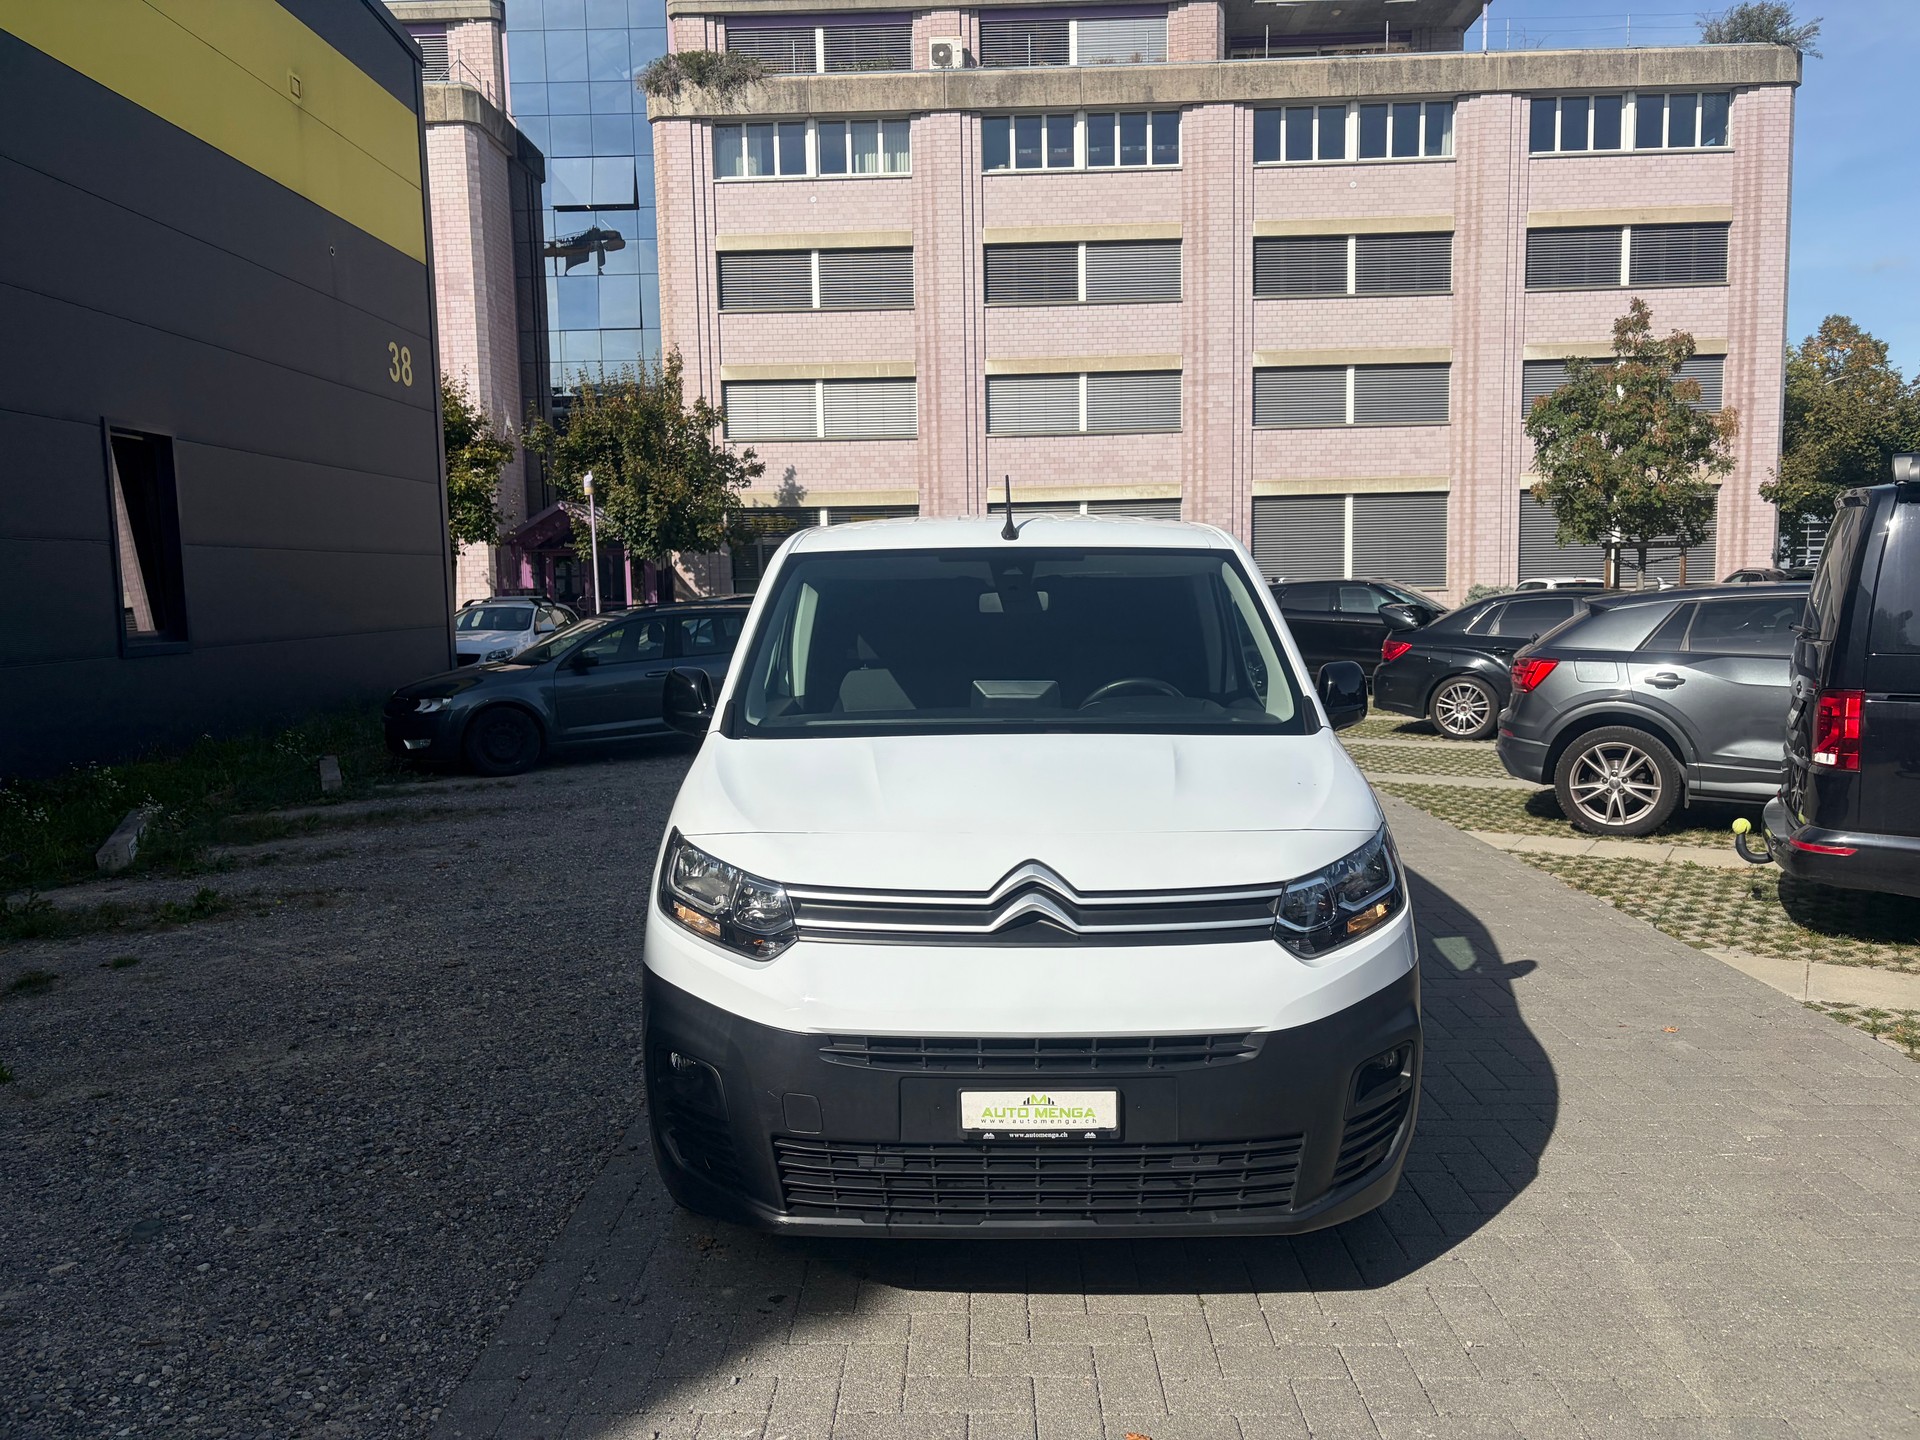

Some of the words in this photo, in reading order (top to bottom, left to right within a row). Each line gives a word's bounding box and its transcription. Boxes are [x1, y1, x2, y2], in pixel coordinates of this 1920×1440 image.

[388, 341, 413, 387] 38
[981, 1107, 1030, 1118] AUTO
[1035, 1107, 1096, 1118] MENGA
